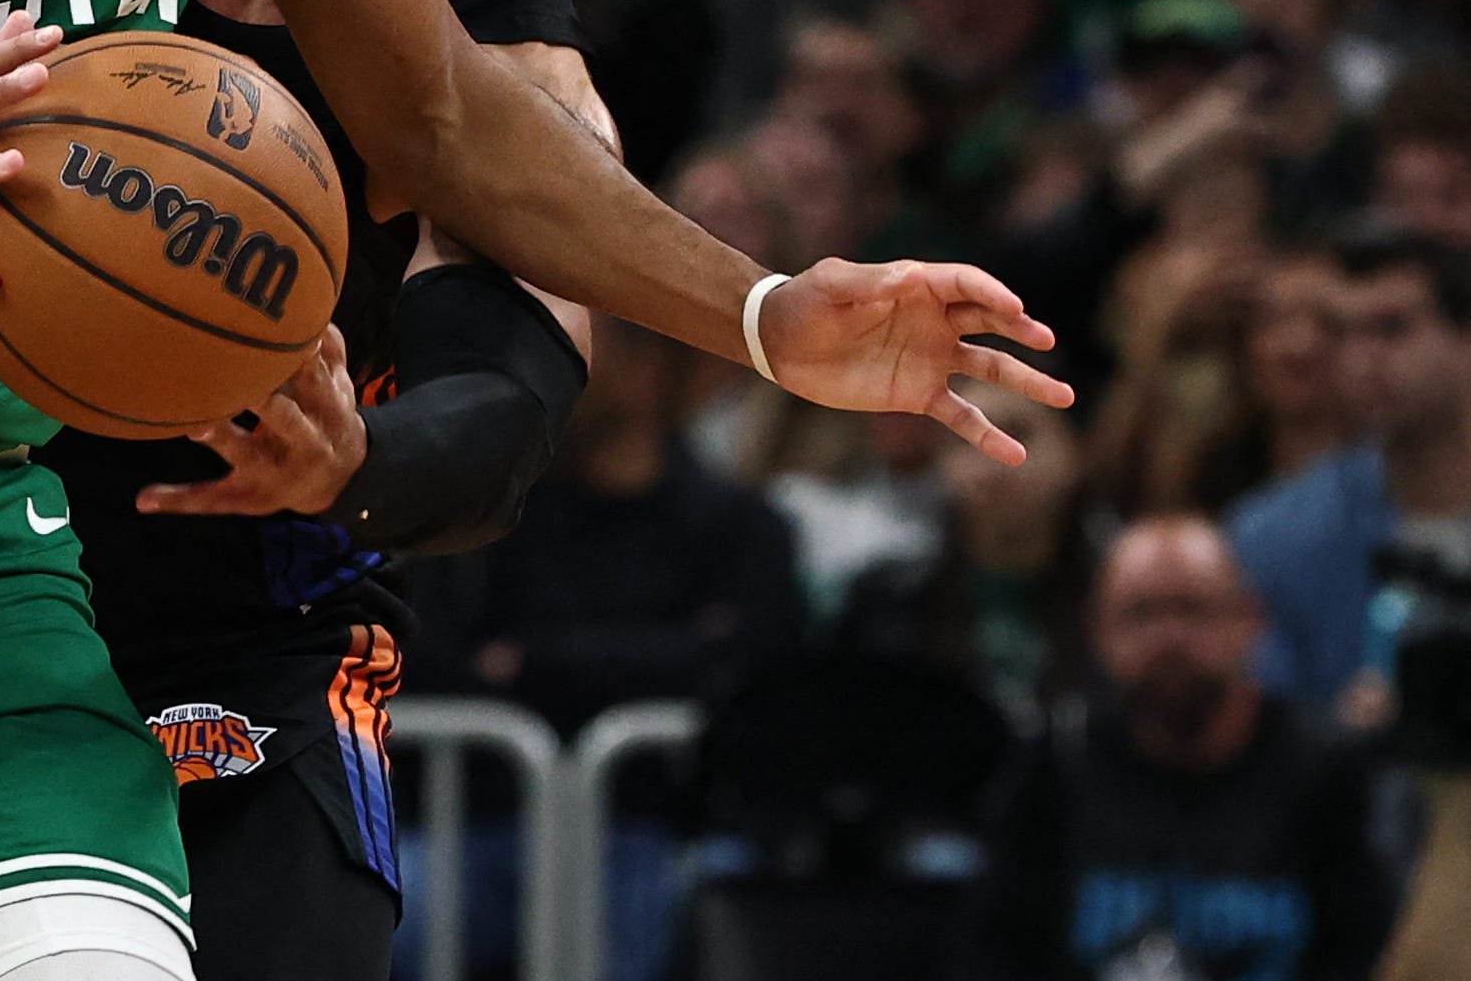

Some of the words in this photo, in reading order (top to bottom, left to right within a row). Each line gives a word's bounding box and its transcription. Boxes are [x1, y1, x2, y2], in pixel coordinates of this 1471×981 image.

[58, 140, 300, 323] Wilson
[162, 706, 188, 724] NEW
[191, 706, 220, 720] YORK
[151, 717, 259, 763] NICKS
